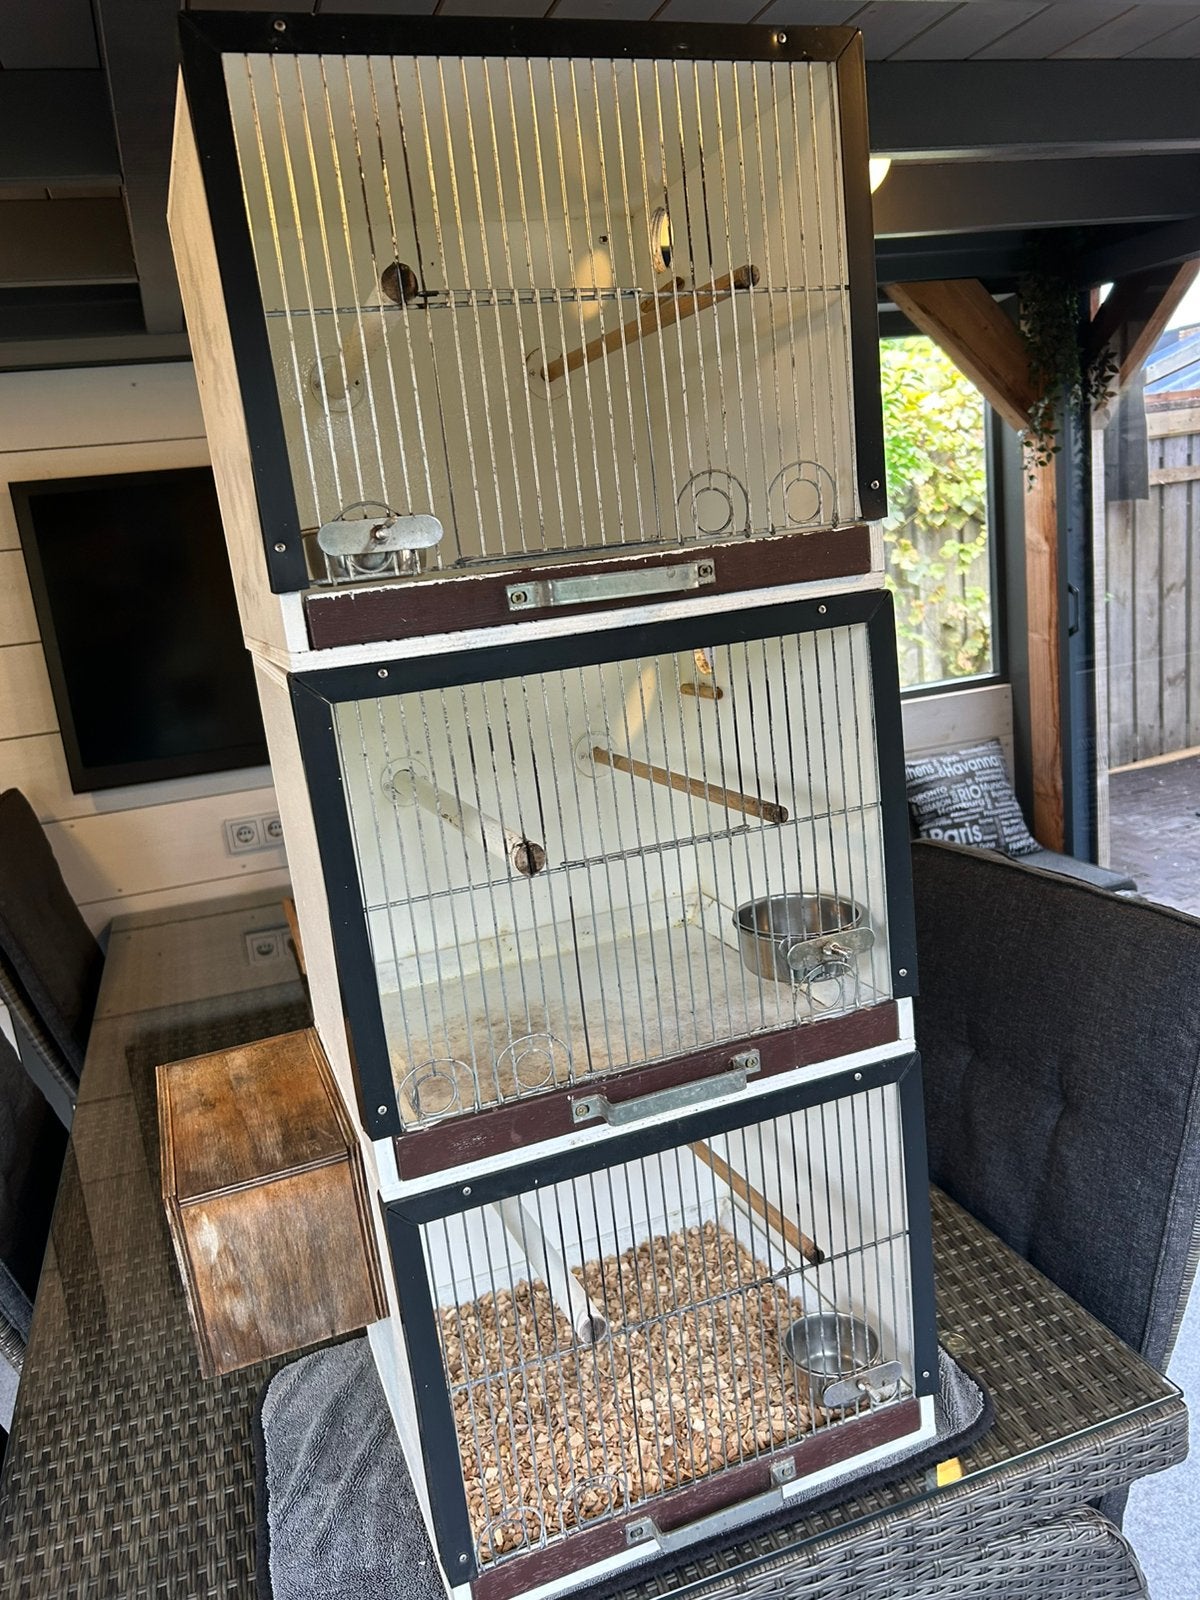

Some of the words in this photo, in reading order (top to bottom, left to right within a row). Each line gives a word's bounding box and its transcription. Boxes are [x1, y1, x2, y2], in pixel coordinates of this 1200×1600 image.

[943, 755, 1000, 777] Havanna
[957, 785, 982, 804] RIO
[929, 822, 983, 843] Paris
